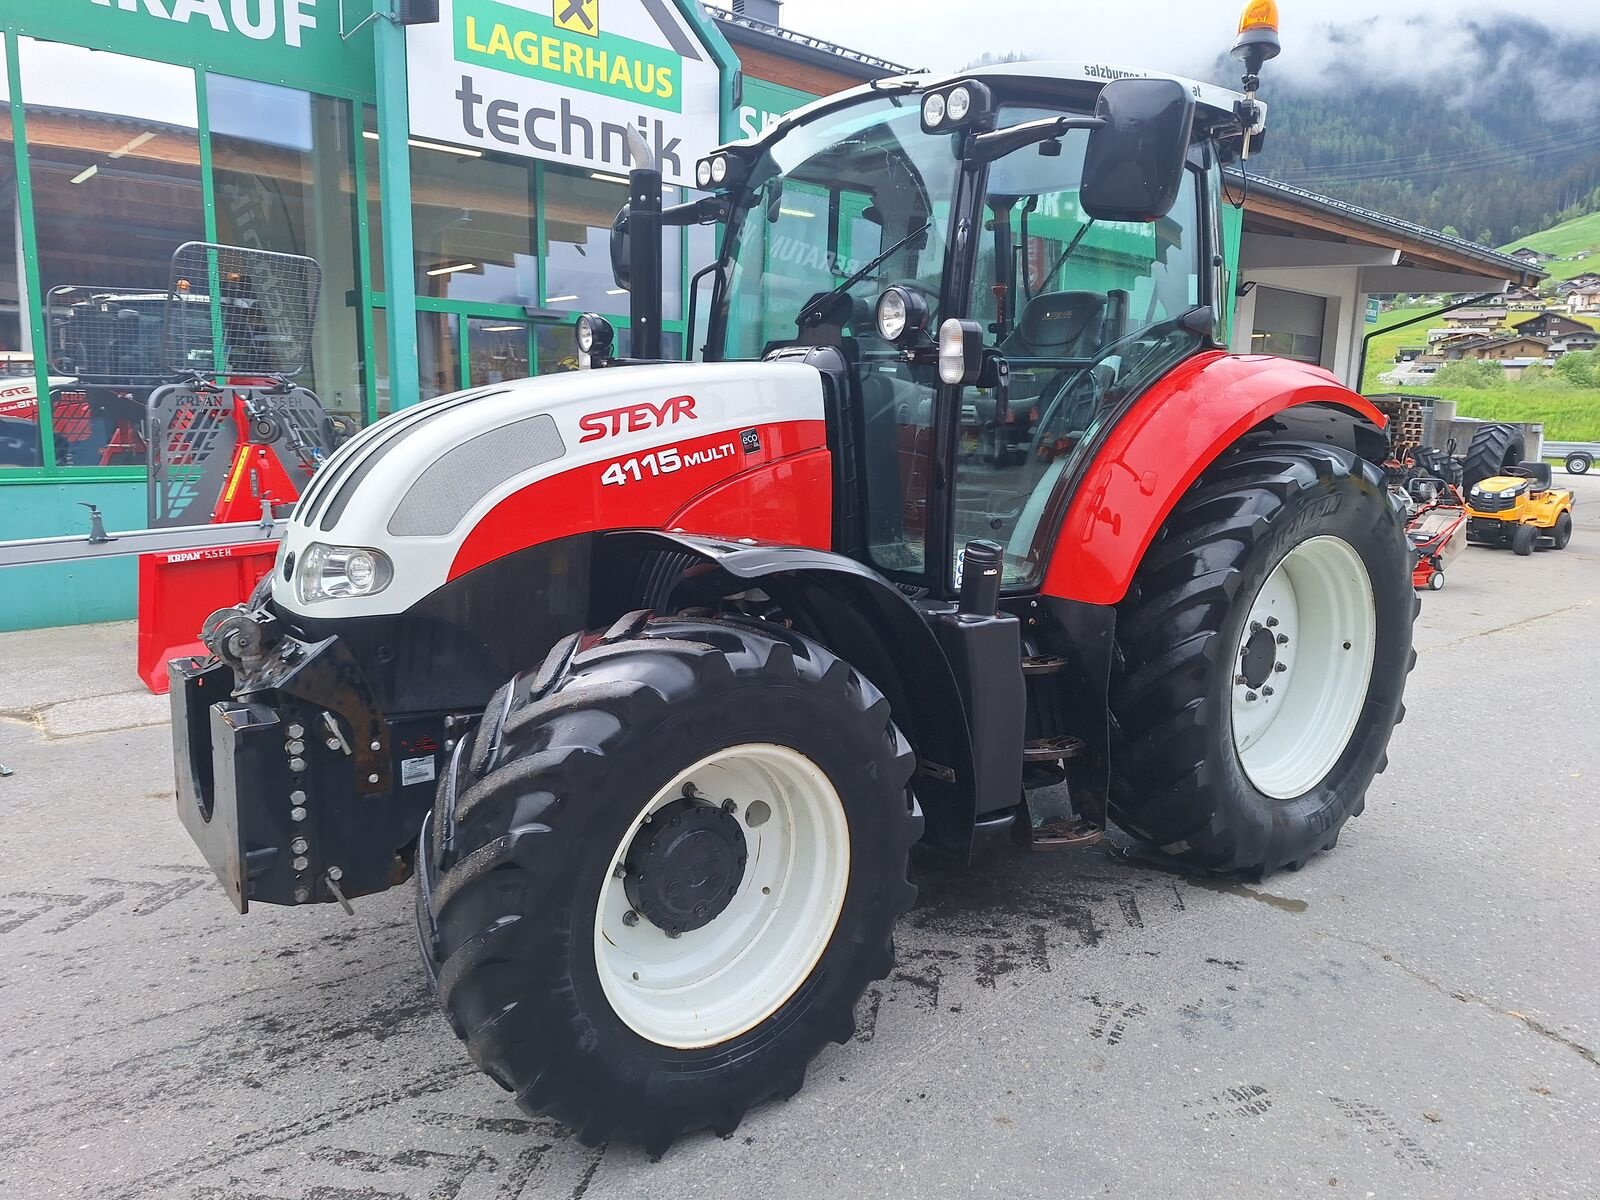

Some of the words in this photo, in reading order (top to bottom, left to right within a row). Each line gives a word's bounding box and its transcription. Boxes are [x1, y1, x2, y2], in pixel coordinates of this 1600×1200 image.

[465, 15, 673, 98] LAGERHAUS
[579, 395, 698, 443] STEYR
[742, 434, 758, 445] eco
[601, 447, 682, 486] 4115
[684, 443, 736, 468] MULTI
